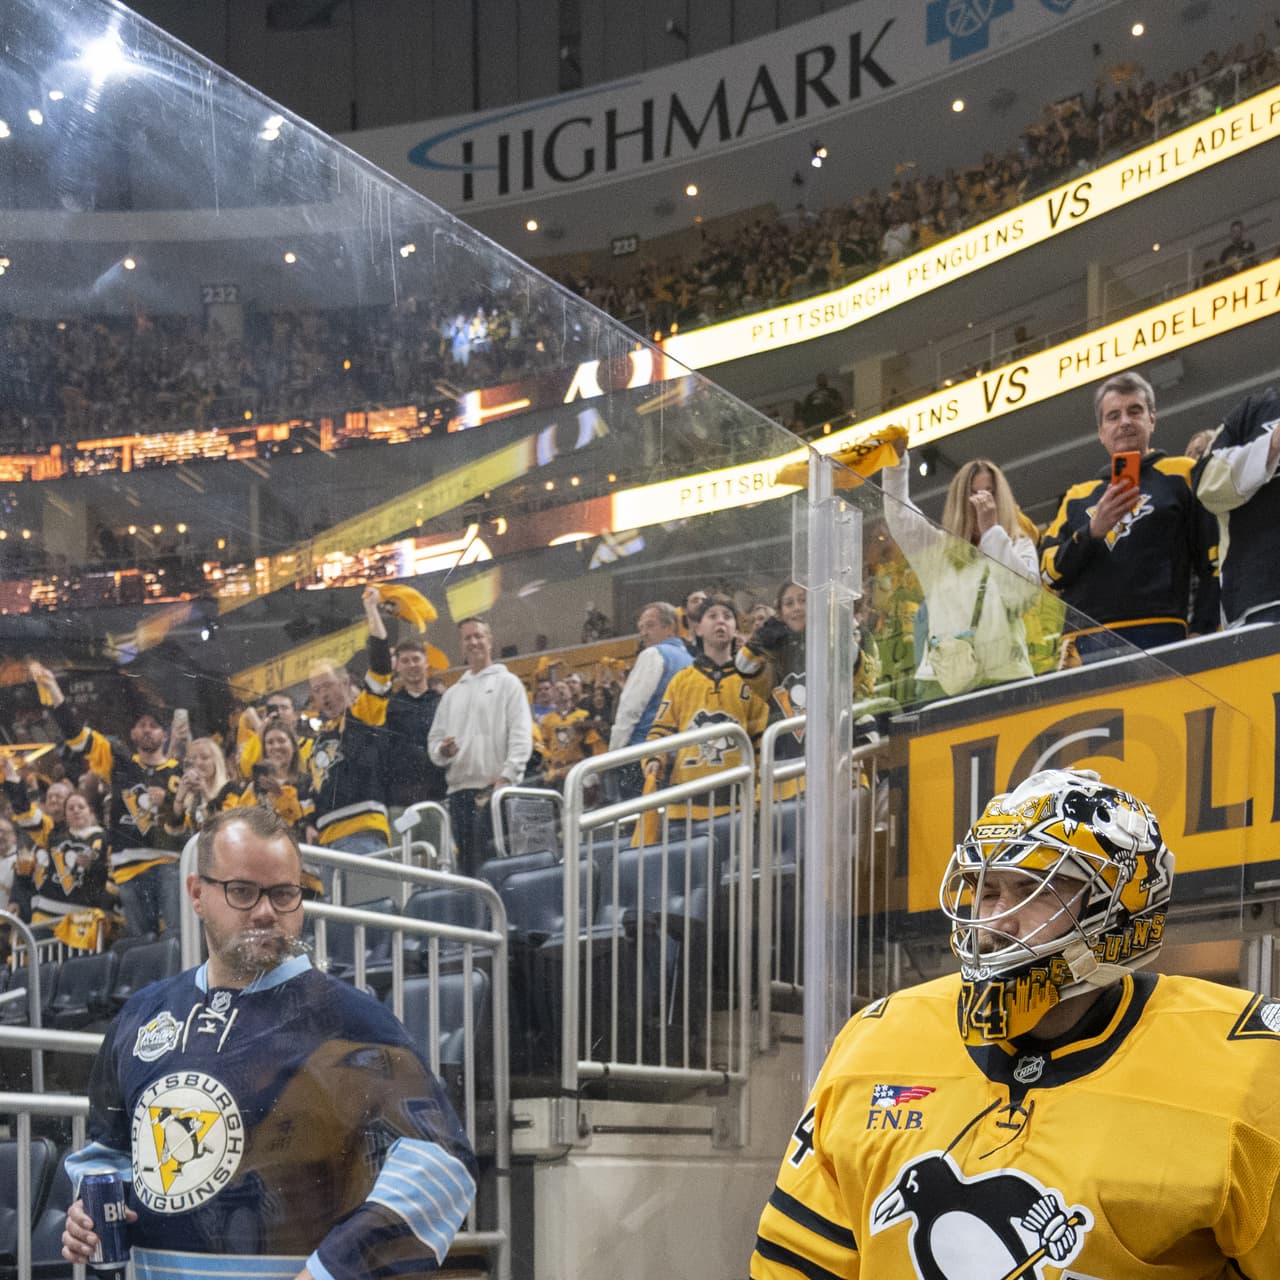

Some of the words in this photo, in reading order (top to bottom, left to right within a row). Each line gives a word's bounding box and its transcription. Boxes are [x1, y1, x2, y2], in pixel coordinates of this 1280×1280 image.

[461, 18, 898, 201] HIGHMARK
[752, 283, 891, 342] PITTSBURGH
[907, 219, 1025, 287] PENGUINS
[1047, 181, 1093, 230] VS
[680, 471, 778, 505] PITTSBU
[982, 366, 1029, 414] VS
[977, 824, 1024, 839] CCM
[1030, 912, 1168, 988] PEGUINS
[131, 1074, 243, 1155] PITTSBURGH
[866, 1109, 924, 1131] F.N.B.
[132, 1160, 232, 1212] PENGUINS
